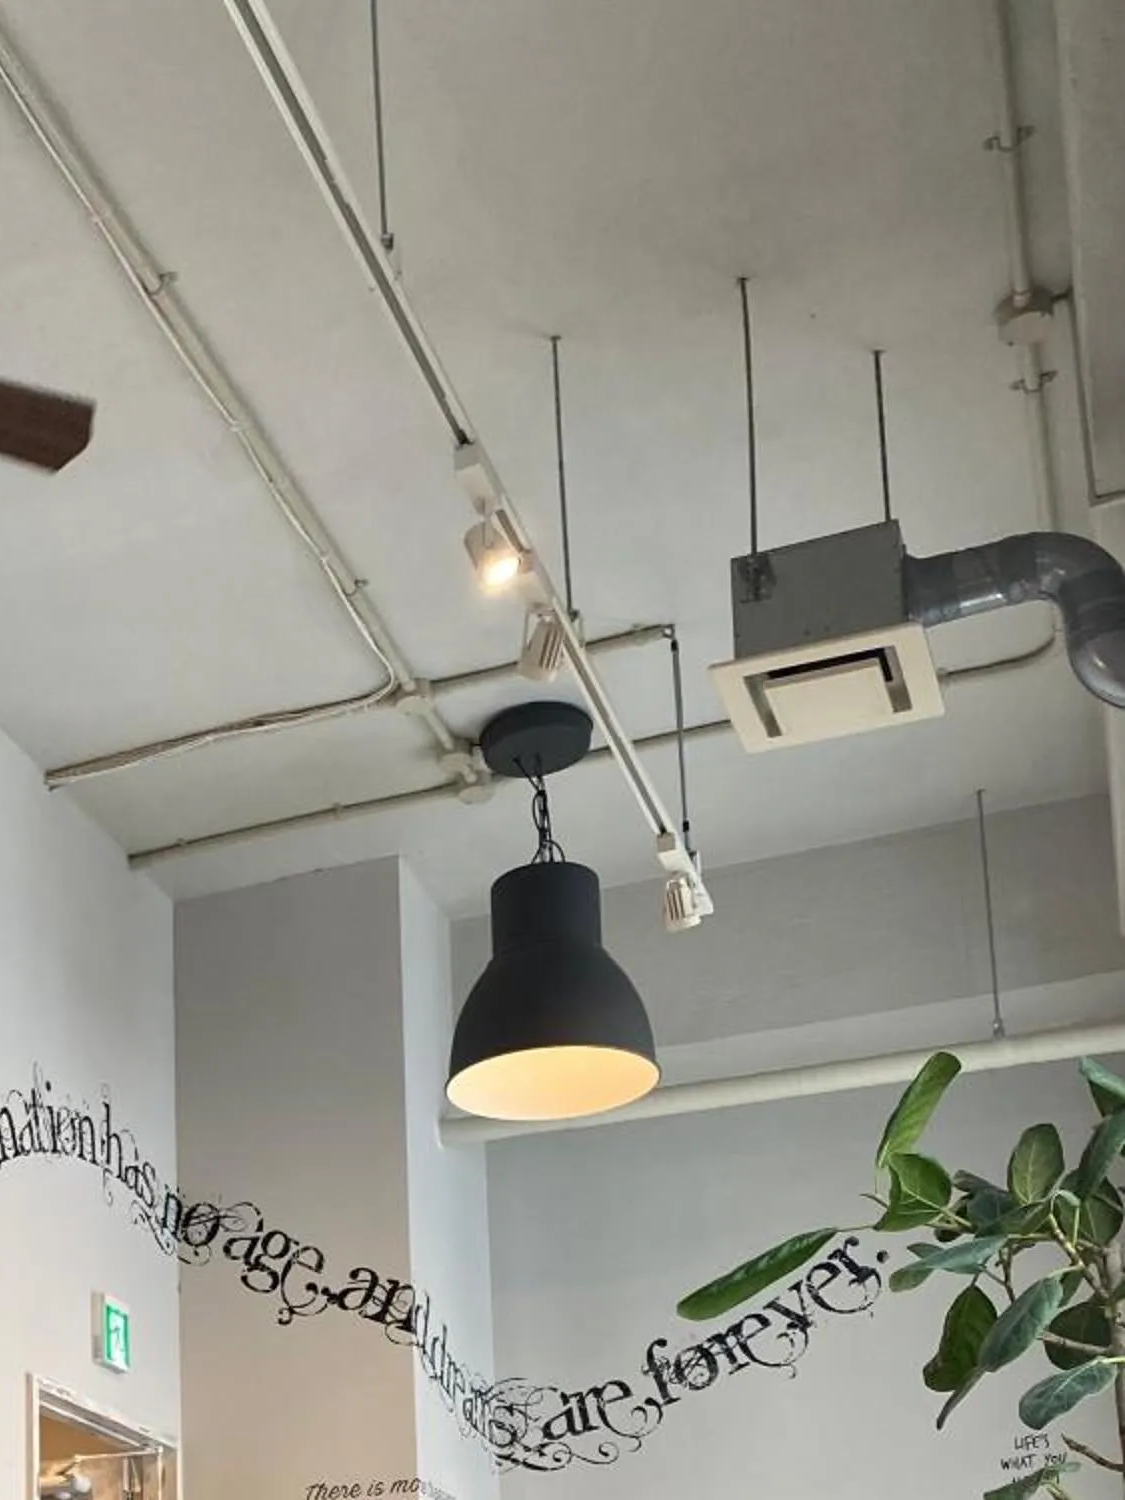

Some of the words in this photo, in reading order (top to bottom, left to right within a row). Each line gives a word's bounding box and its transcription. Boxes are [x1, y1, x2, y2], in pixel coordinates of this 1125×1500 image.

[1000, 1454, 1036, 1470] WHAT
[1045, 1452, 1067, 1467] YOU
[367, 1478, 385, 1497] is
